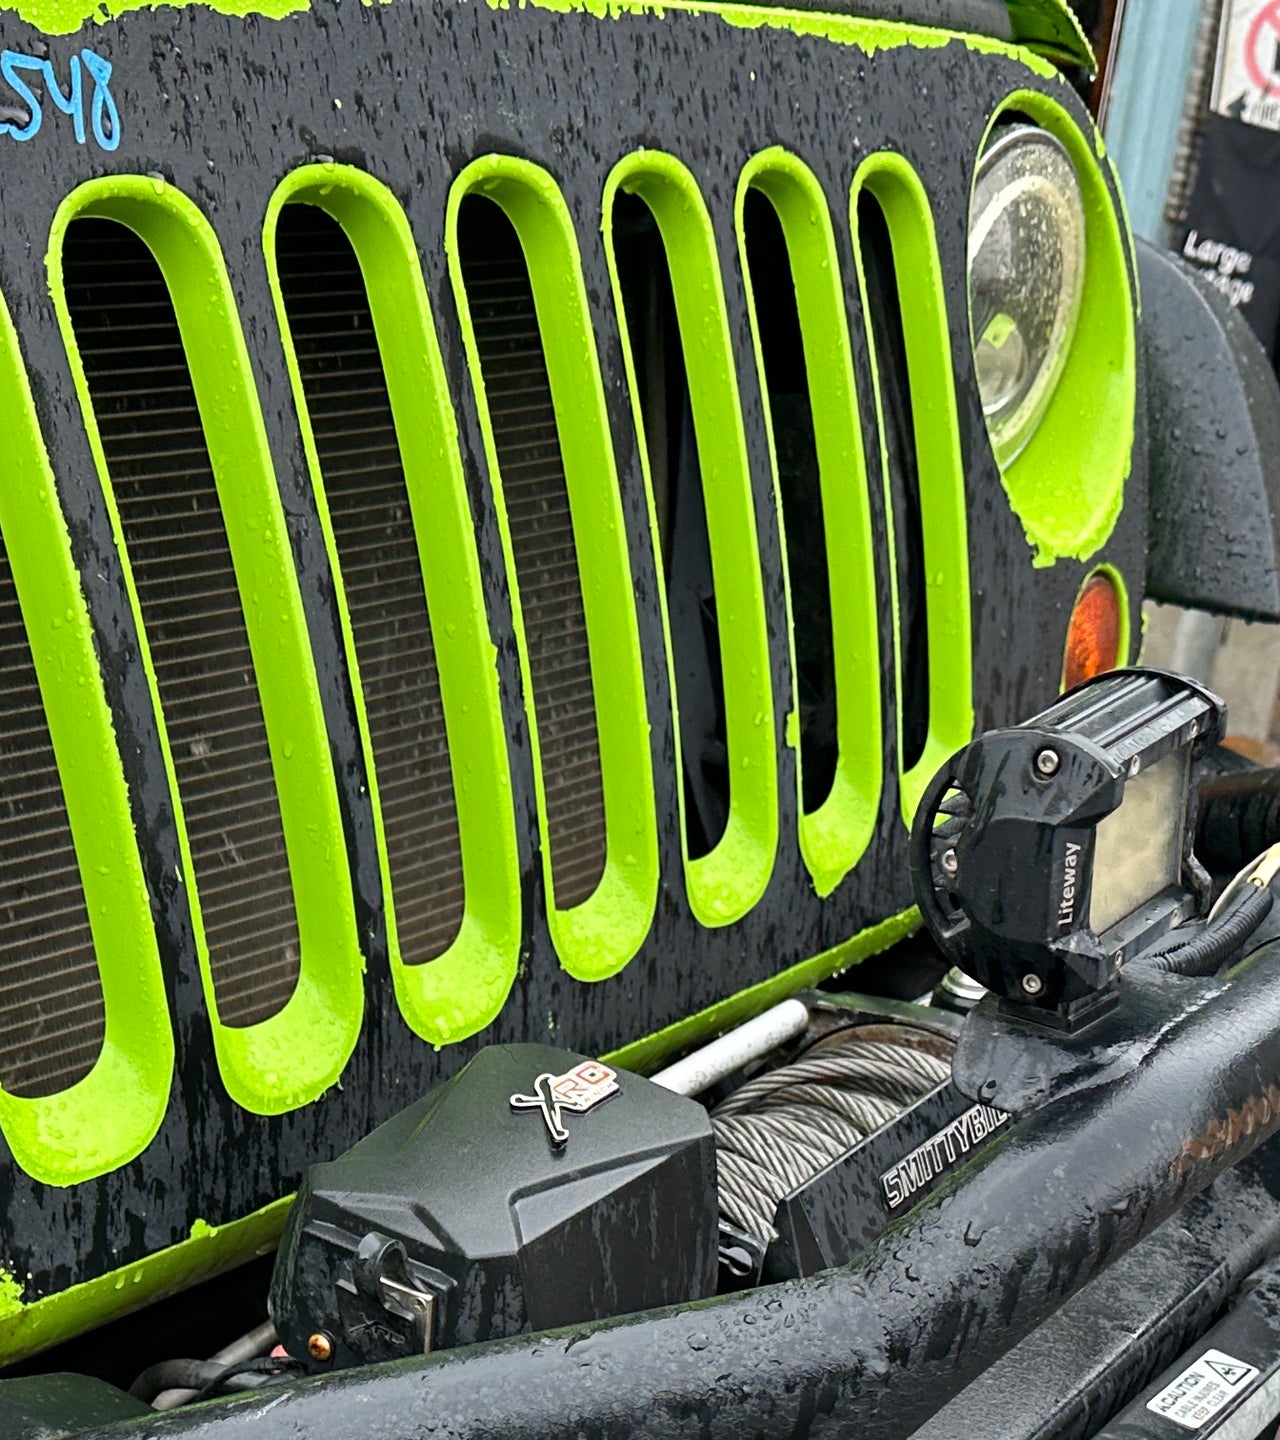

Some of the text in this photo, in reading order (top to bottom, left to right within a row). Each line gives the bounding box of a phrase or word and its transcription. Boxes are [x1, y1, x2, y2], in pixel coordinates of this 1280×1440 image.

[1183, 229, 1252, 274] Large
[1057, 842, 1081, 925] Liteway
[882, 1104, 1012, 1208] SMITTYBIL
[1164, 1371, 1205, 1408] CAUTION
